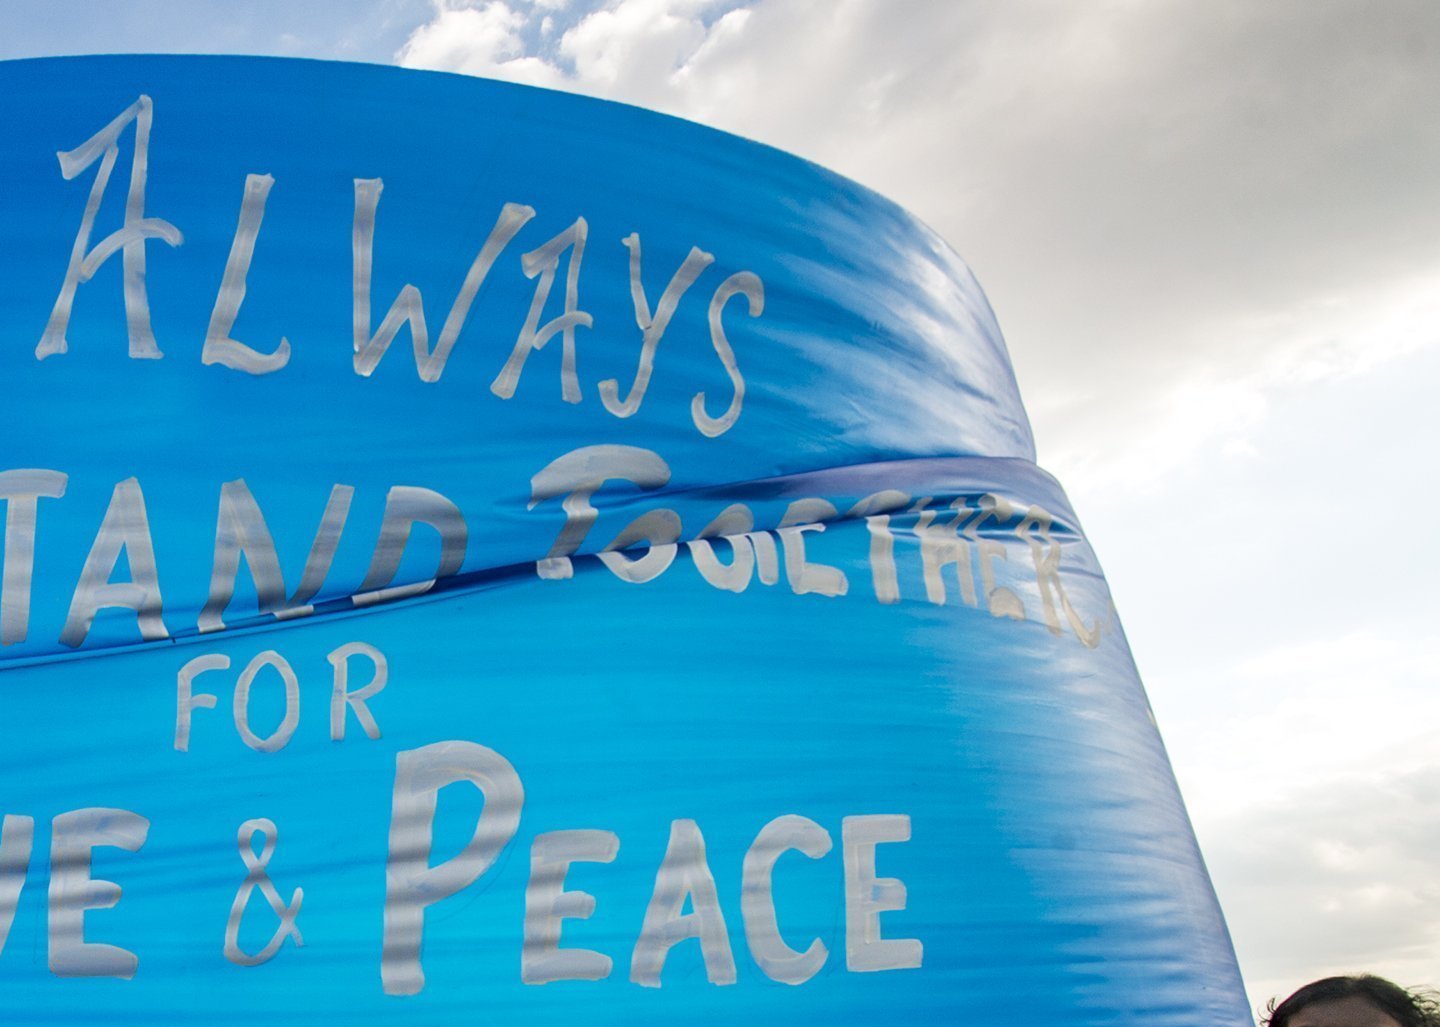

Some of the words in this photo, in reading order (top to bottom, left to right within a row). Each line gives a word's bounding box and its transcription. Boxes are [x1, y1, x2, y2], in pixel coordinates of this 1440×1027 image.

[35, 94, 765, 438] ALWAYS
[527, 443, 1102, 650] TOGETHER
[173, 641, 388, 754] FOR
[223, 817, 304, 967] &
[380, 740, 925, 996] PEACE
